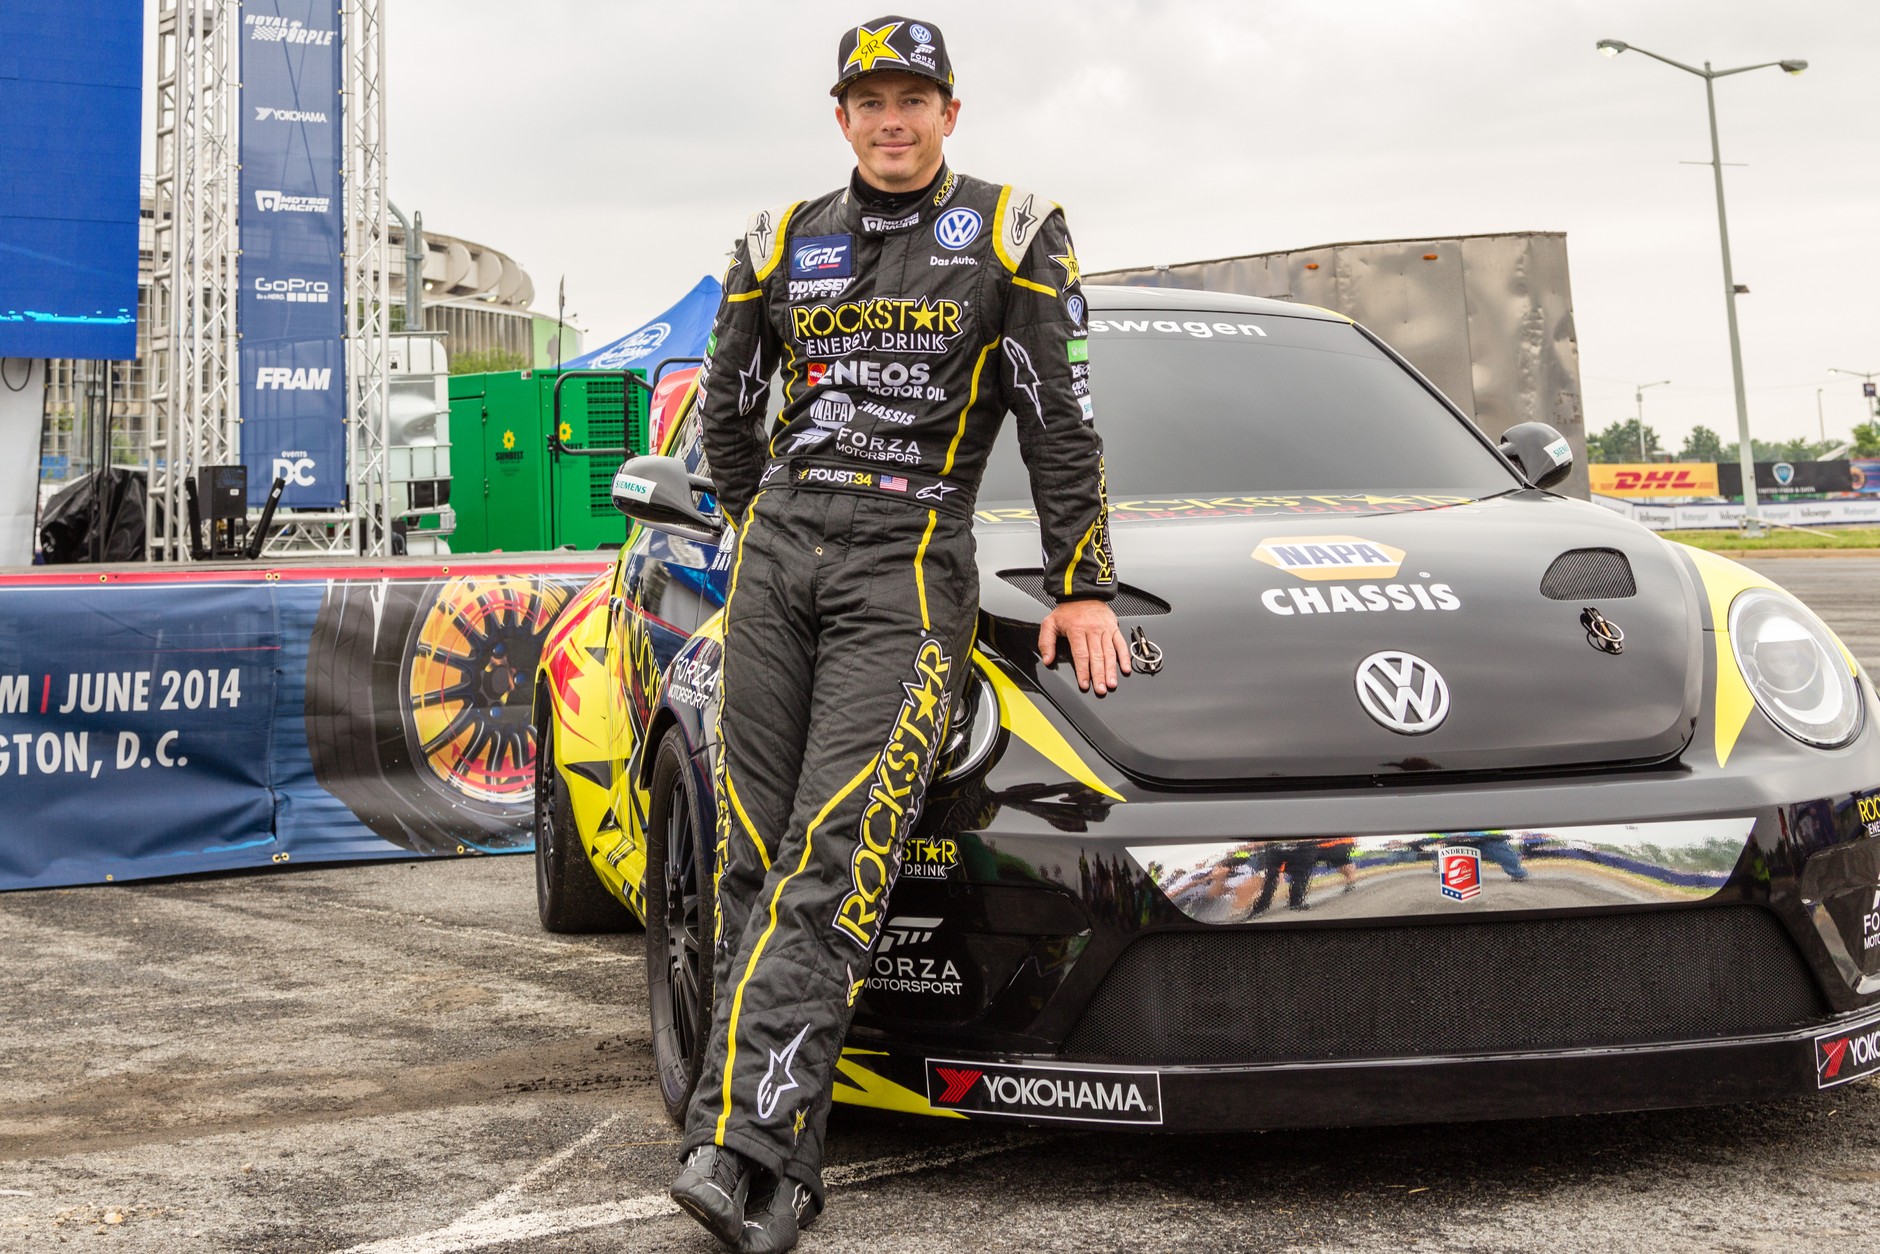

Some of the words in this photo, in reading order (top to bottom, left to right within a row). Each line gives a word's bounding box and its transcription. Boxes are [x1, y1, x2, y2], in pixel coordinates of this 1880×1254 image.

[245, 14, 288, 27] ROYAL
[276, 27, 333, 45] PURPLE
[911, 52, 936, 67] FORZA
[273, 109, 327, 122] YOKOHAMA
[281, 195, 329, 205] MOTEGI
[883, 212, 919, 227] MOTEGI
[804, 246, 847, 267] GRC
[930, 256, 949, 266] Das
[951, 256, 978, 266] Auto.
[255, 277, 329, 292] GoPro
[789, 278, 852, 294] ODYSSEY
[807, 332, 871, 355] ENERGY
[882, 332, 944, 350] DRINK
[256, 367, 331, 391] FRAM
[817, 360, 930, 387] ENEOS
[867, 386, 922, 399] MOTOR
[926, 386, 947, 401] OIL
[814, 399, 851, 422] NAPA
[837, 427, 921, 455] FORZA
[835, 442, 922, 465] MOTORSPORT
[615, 480, 647, 495] SIEMENS
[1615, 471, 1697, 490] DHL
[1270, 543, 1392, 566] NAPA
[1261, 583, 1462, 615] CHASSIS
[673, 656, 720, 692] FORZA
[59, 671, 149, 714] JUNE
[161, 668, 241, 709] 2014
[668, 683, 709, 709] MOTORSPORT
[116, 730, 188, 770] D.C.
[1441, 848, 1478, 857] ANDRETTI
[905, 864, 945, 877] DRINK
[874, 957, 961, 980] ORZA
[982, 1074, 1147, 1113] YOKOHAMA
